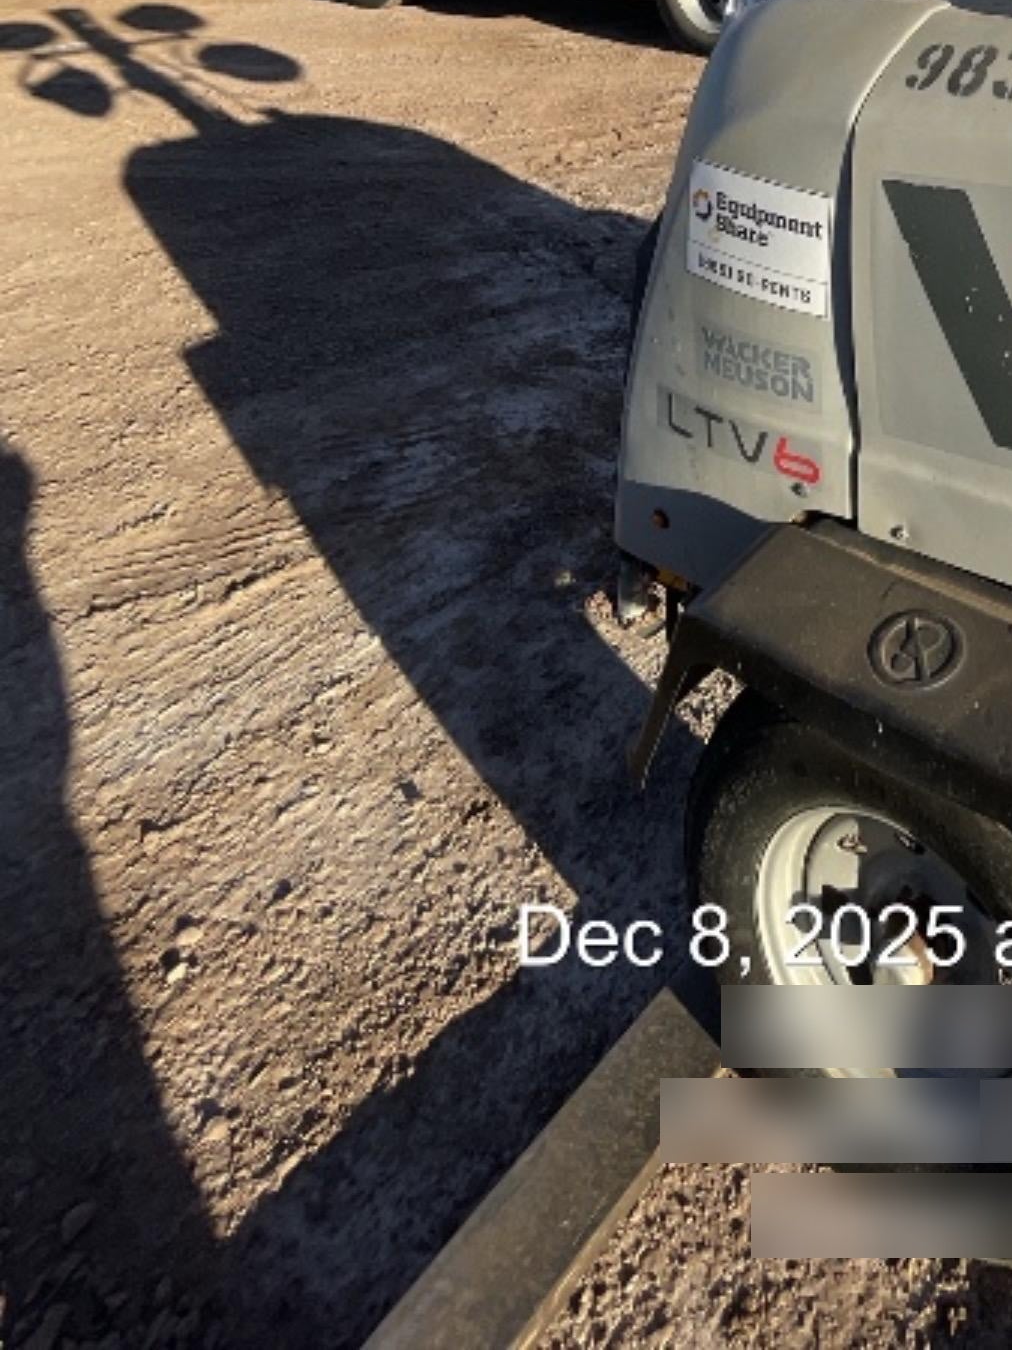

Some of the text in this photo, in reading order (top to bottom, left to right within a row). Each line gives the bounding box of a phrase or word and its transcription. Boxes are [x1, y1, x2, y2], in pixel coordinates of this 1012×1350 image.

[702, 326, 811, 379] WACKER
[703, 351, 814, 403] NEUSON
[668, 393, 820, 484] LTV6
